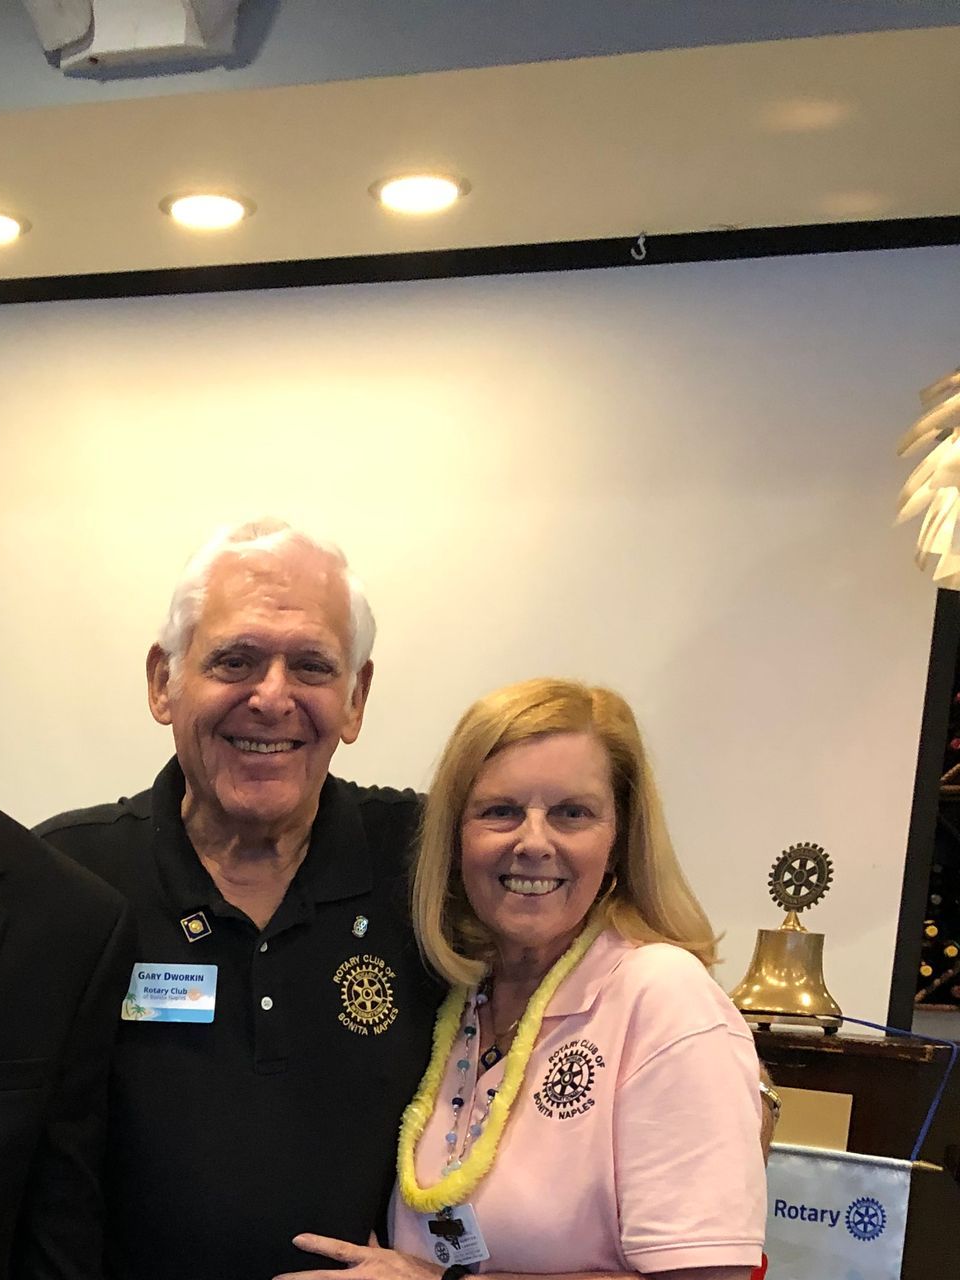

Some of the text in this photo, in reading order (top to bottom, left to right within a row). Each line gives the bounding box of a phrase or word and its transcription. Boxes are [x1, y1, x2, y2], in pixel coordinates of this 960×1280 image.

[332, 954, 397, 983] ROTARY CLUB OF
[143, 987, 188, 995] Rotary Club
[338, 1012, 368, 1036] BONITA
[373, 1007, 399, 1036] NAPLES
[548, 1040, 580, 1064] ROTARY
[580, 1039, 599, 1055] CLUB
[595, 1055, 605, 1068] OF
[533, 1092, 553, 1118] BONITA
[559, 1098, 595, 1120] NAPLES
[774, 1199, 840, 1227] Rotary
